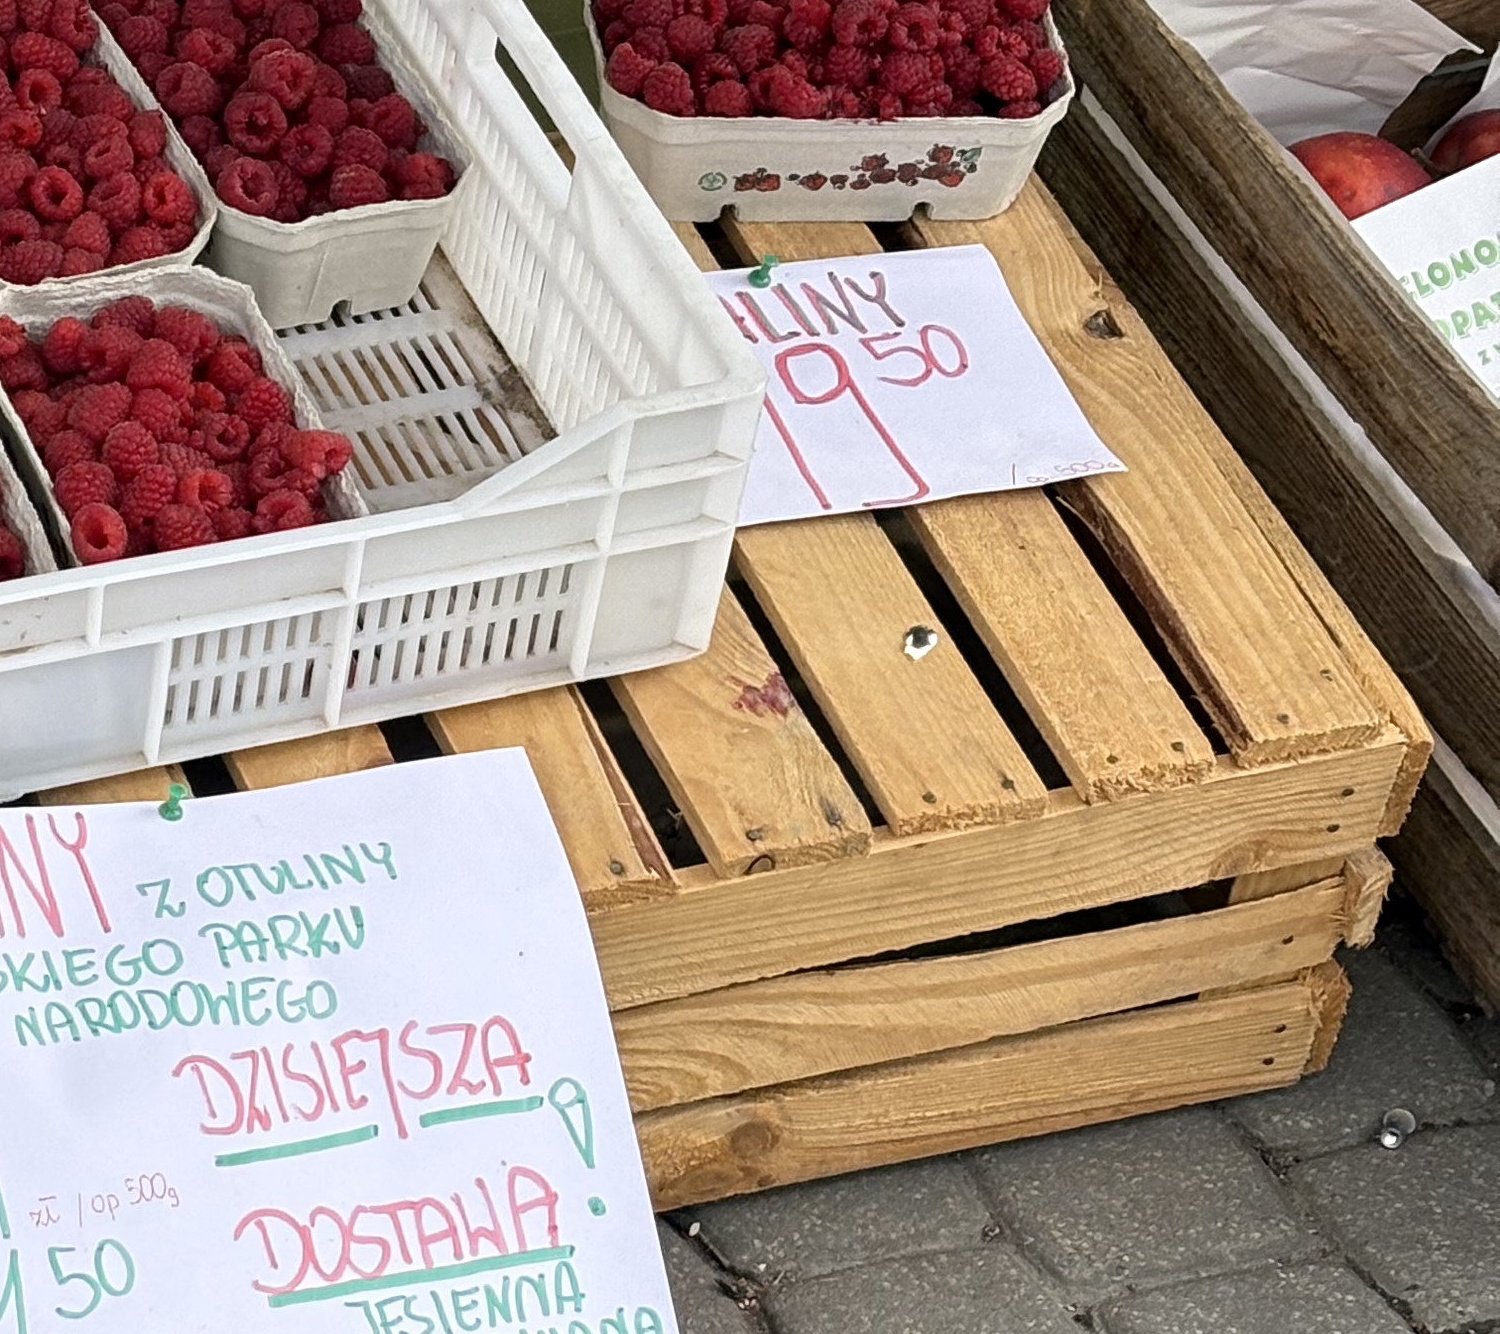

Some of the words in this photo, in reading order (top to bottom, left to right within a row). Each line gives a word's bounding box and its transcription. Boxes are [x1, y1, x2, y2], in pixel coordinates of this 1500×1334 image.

[196, 841, 400, 907] OTULINY
[197, 905, 367, 968] PARKU
[15, 976, 339, 1047] NARODOWEGO
[173, 1015, 532, 1139] DZISIEJSZA
[234, 1165, 559, 1294] DOSTAWA
